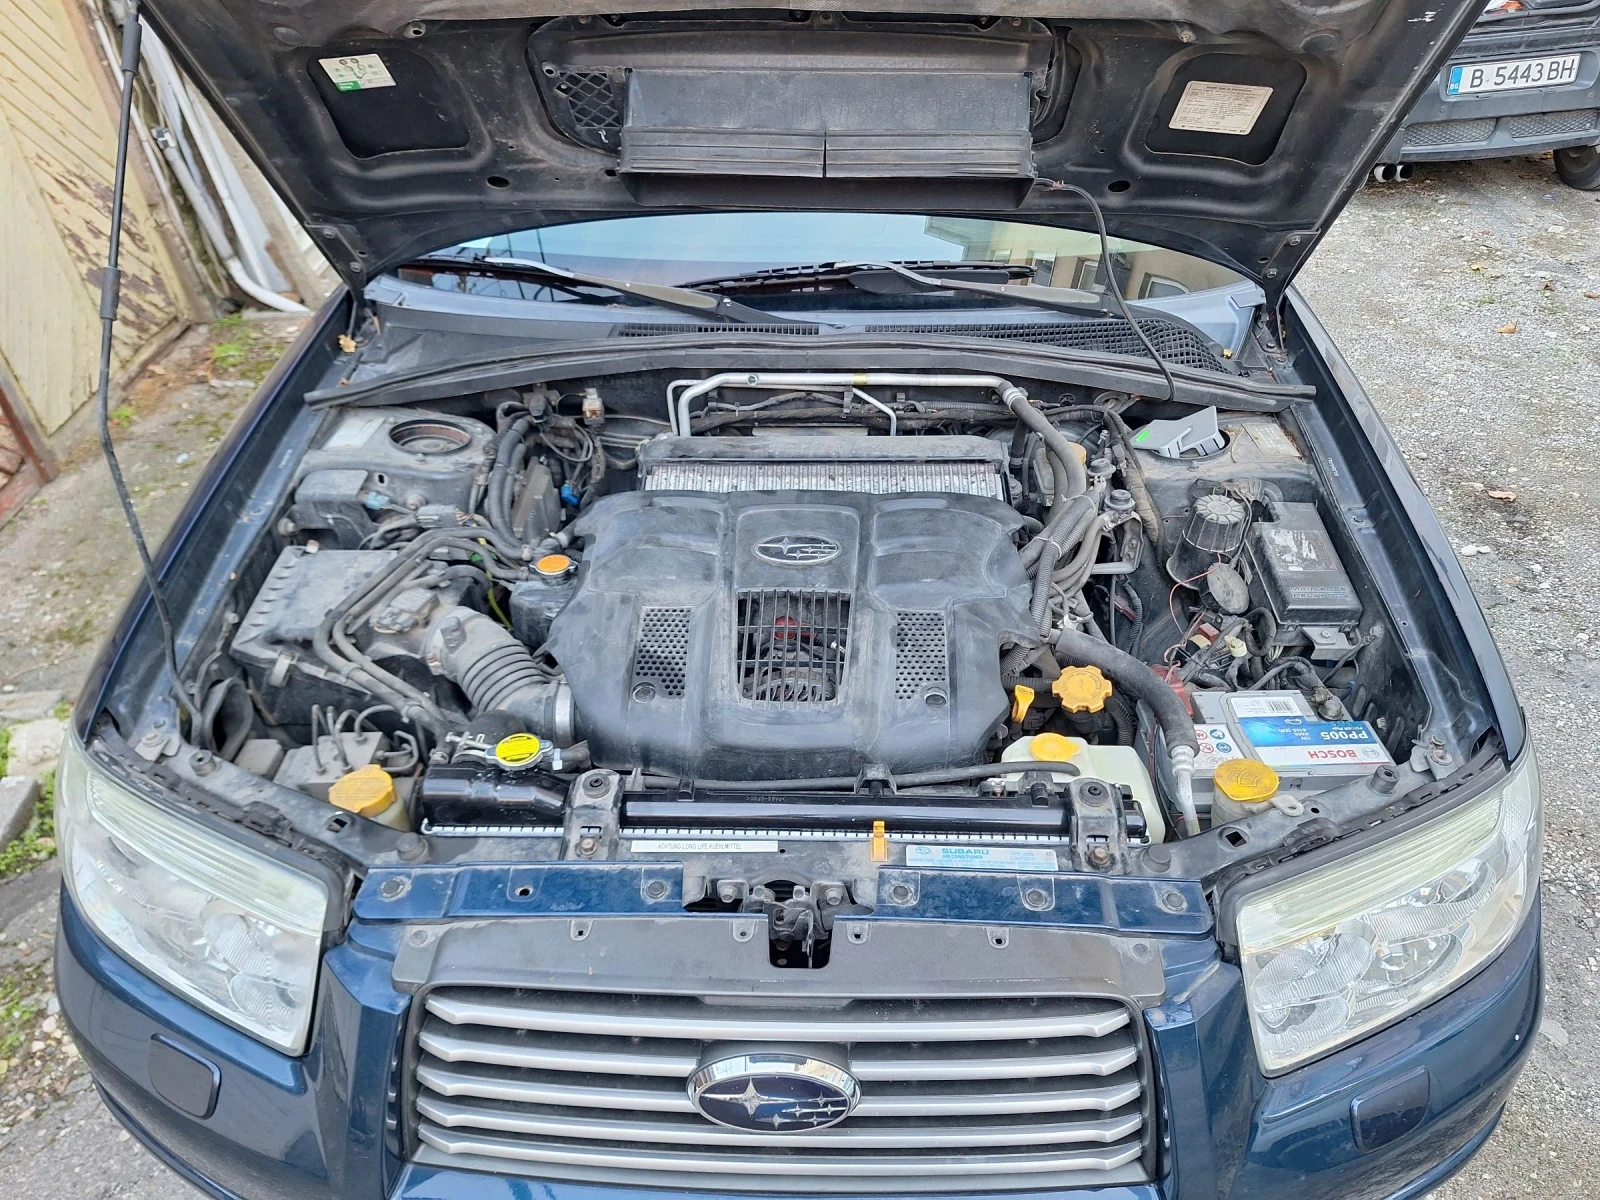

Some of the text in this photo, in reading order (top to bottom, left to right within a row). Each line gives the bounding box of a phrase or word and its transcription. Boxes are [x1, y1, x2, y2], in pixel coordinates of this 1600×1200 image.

[1470, 58, 1575, 89] B 5443 BH
[1320, 731, 1368, 740] PP005
[1308, 750, 1357, 759] BOSCH
[657, 842, 742, 850] ACHTUNG LONG LIFE KUEHLMITTEL
